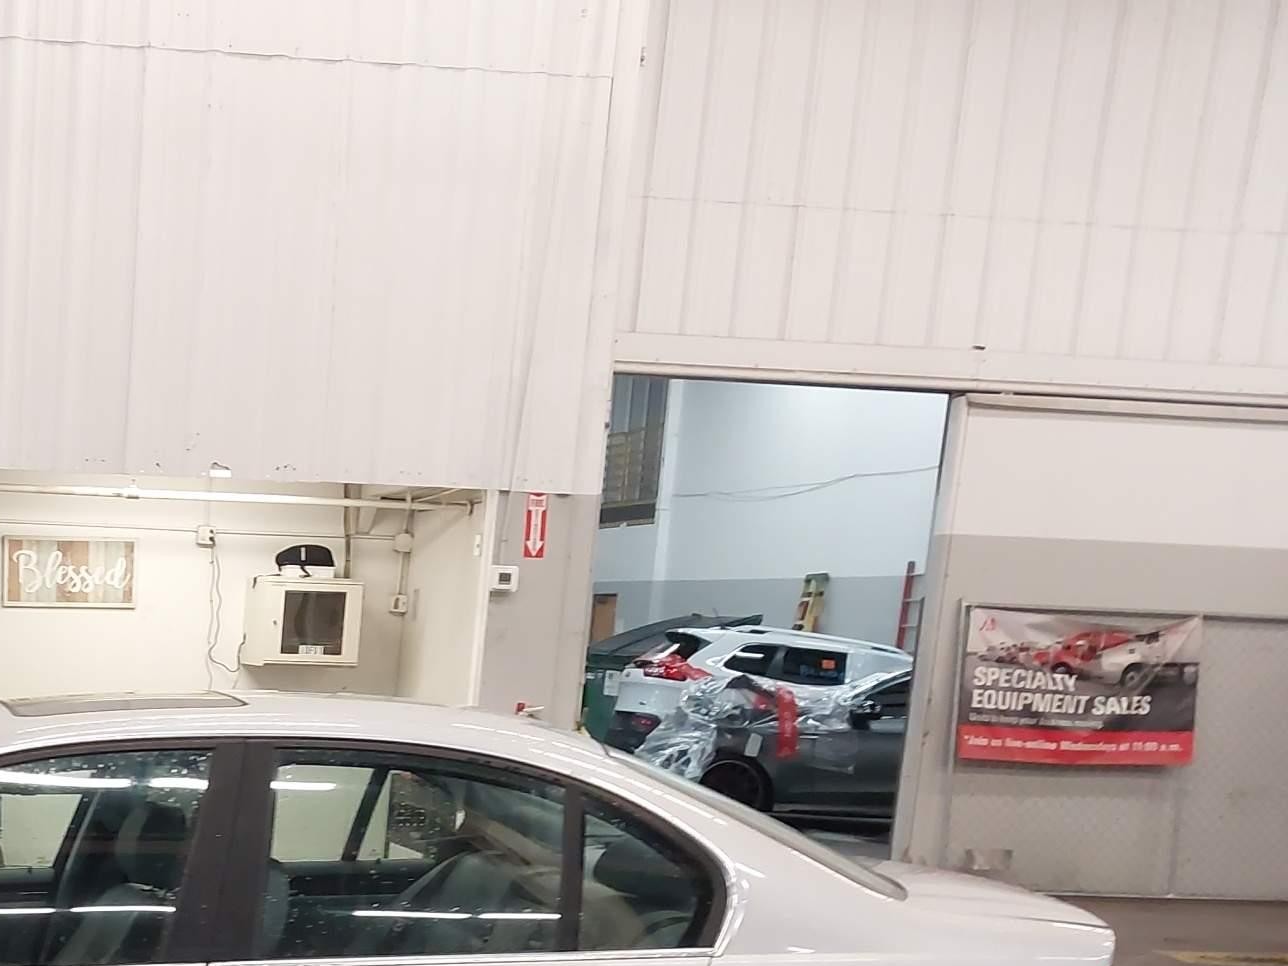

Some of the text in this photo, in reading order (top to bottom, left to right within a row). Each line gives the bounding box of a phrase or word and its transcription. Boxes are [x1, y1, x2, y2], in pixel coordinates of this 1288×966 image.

[13, 549, 131, 593] Blessed
[973, 666, 1078, 692] SPECIALTY
[971, 689, 1152, 715] EQUIPMENT SALES
